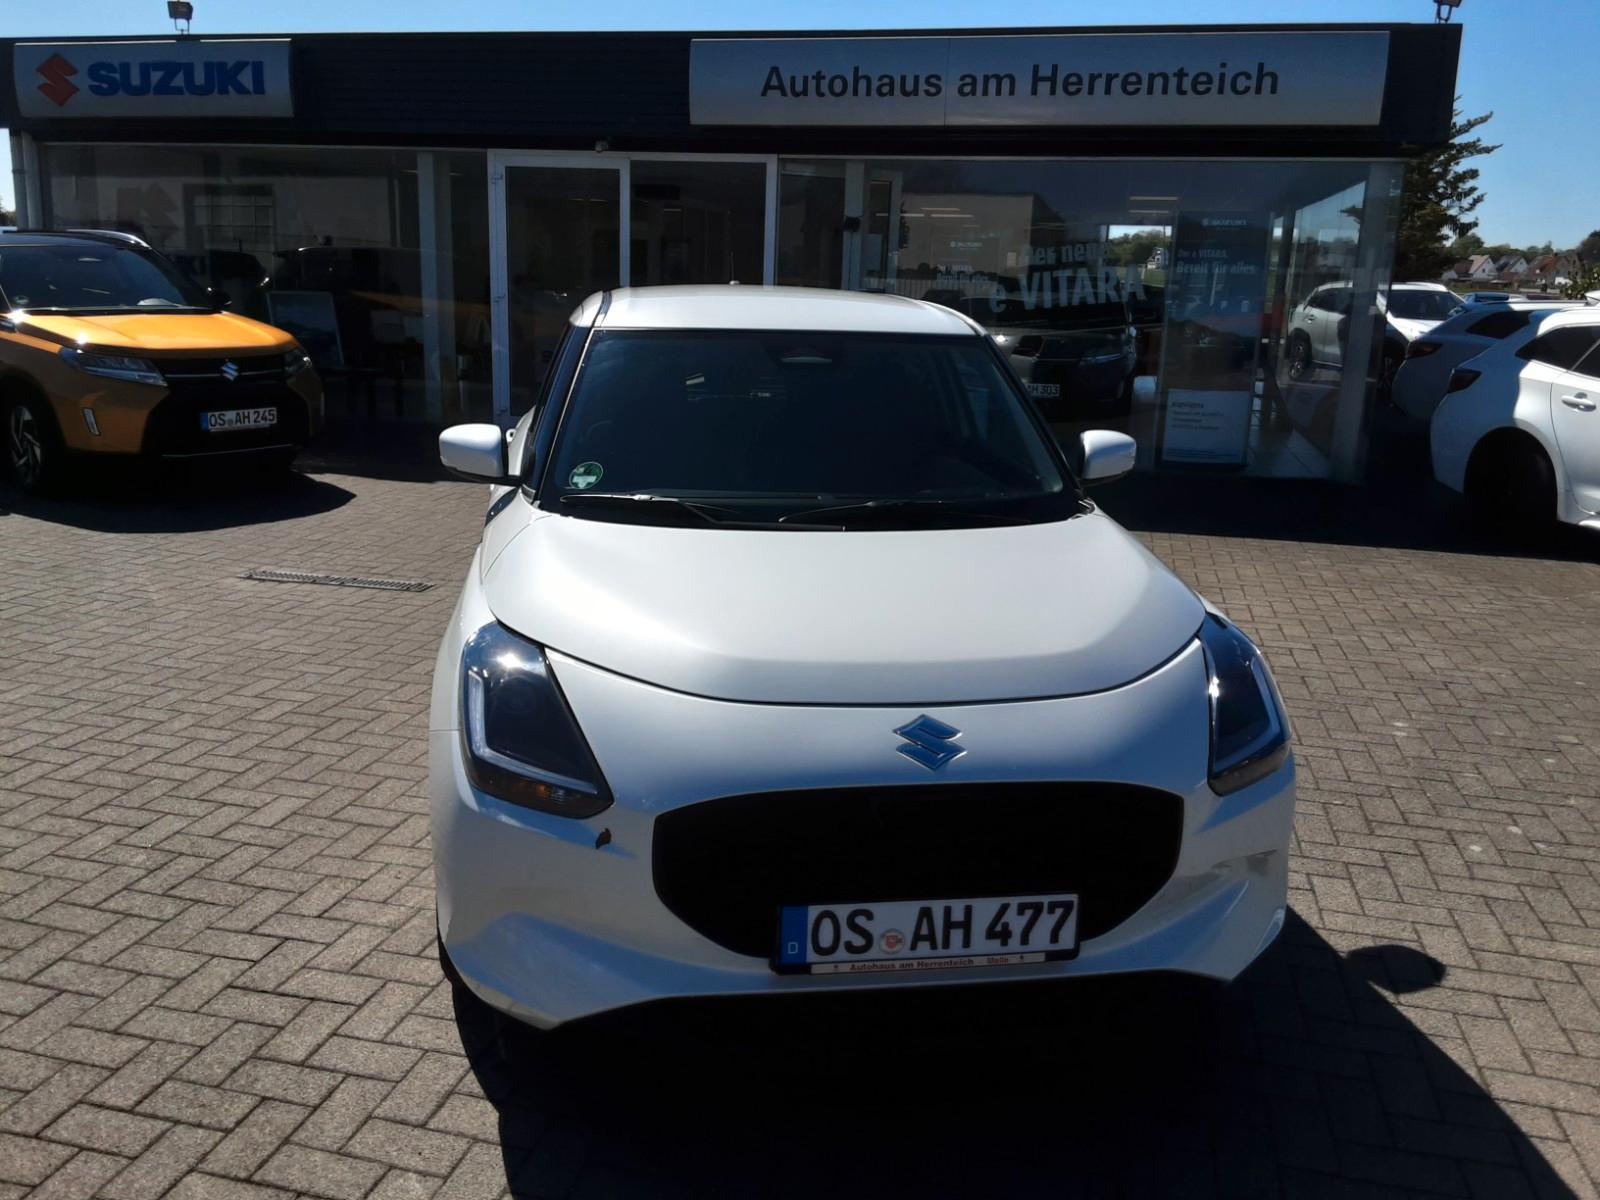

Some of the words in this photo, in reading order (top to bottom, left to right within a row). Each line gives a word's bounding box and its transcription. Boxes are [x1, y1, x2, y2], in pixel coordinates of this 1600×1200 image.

[87, 61, 266, 96] SUZUKI
[760, 65, 943, 98] Autohaus
[957, 71, 1017, 97] am
[1030, 62, 1279, 97] Herrenteich
[1018, 260, 1148, 311] VITARA
[209, 413, 226, 427] OS
[235, 411, 251, 425] AH
[253, 409, 276, 424] 245
[811, 909, 874, 956] OS
[909, 904, 973, 951] AH
[985, 900, 1075, 947] 477
[787, 942, 798, 954] D
[848, 962, 897, 972] Autohaus
[898, 962, 915, 970] am
[917, 958, 974, 969] Herrenteich
